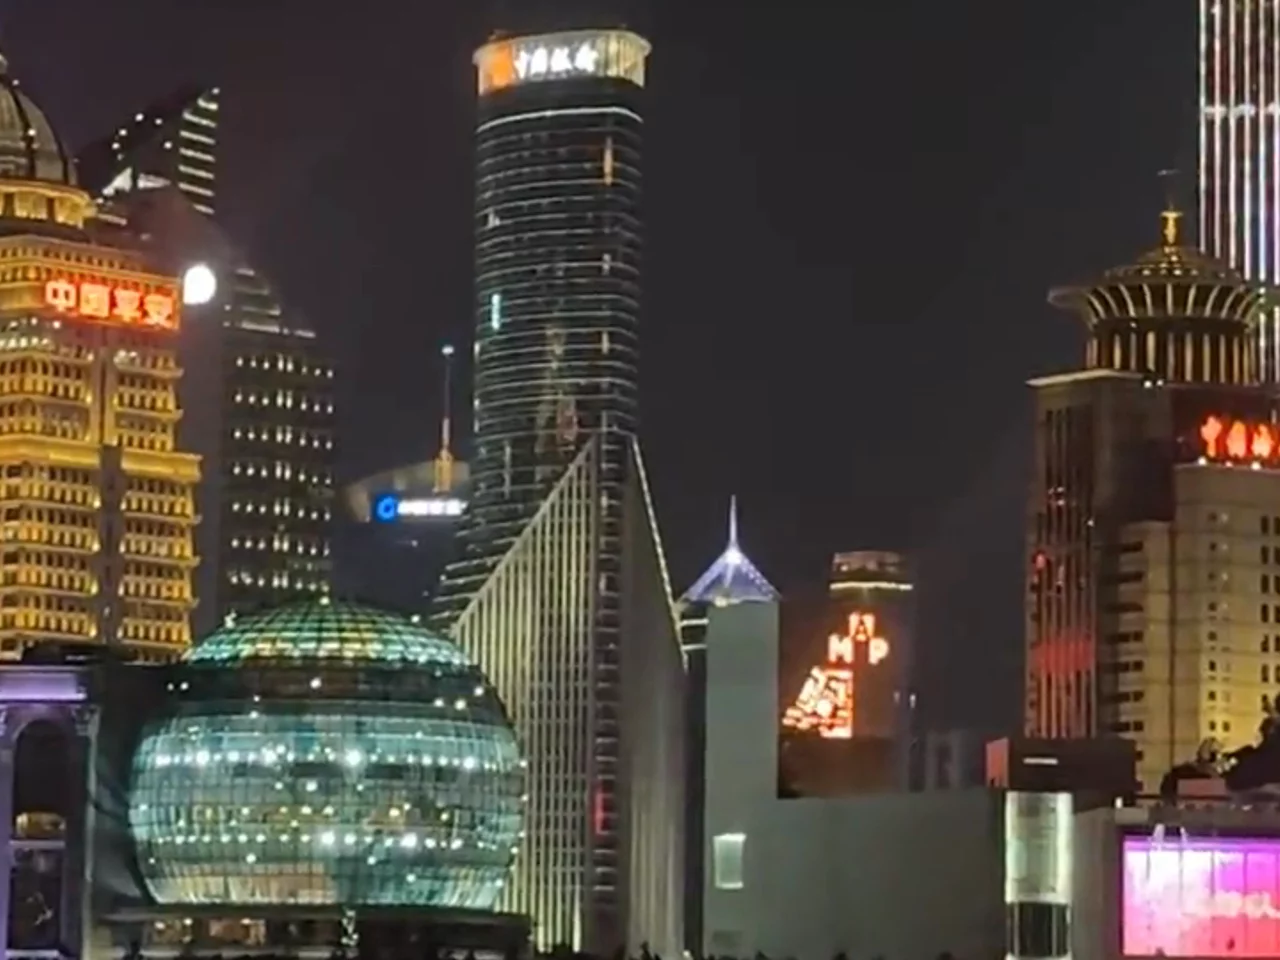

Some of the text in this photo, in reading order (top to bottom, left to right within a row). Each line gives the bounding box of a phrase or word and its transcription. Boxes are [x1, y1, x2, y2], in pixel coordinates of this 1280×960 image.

[46, 279, 173, 328] 中国平安
[828, 611, 889, 665] MAP
